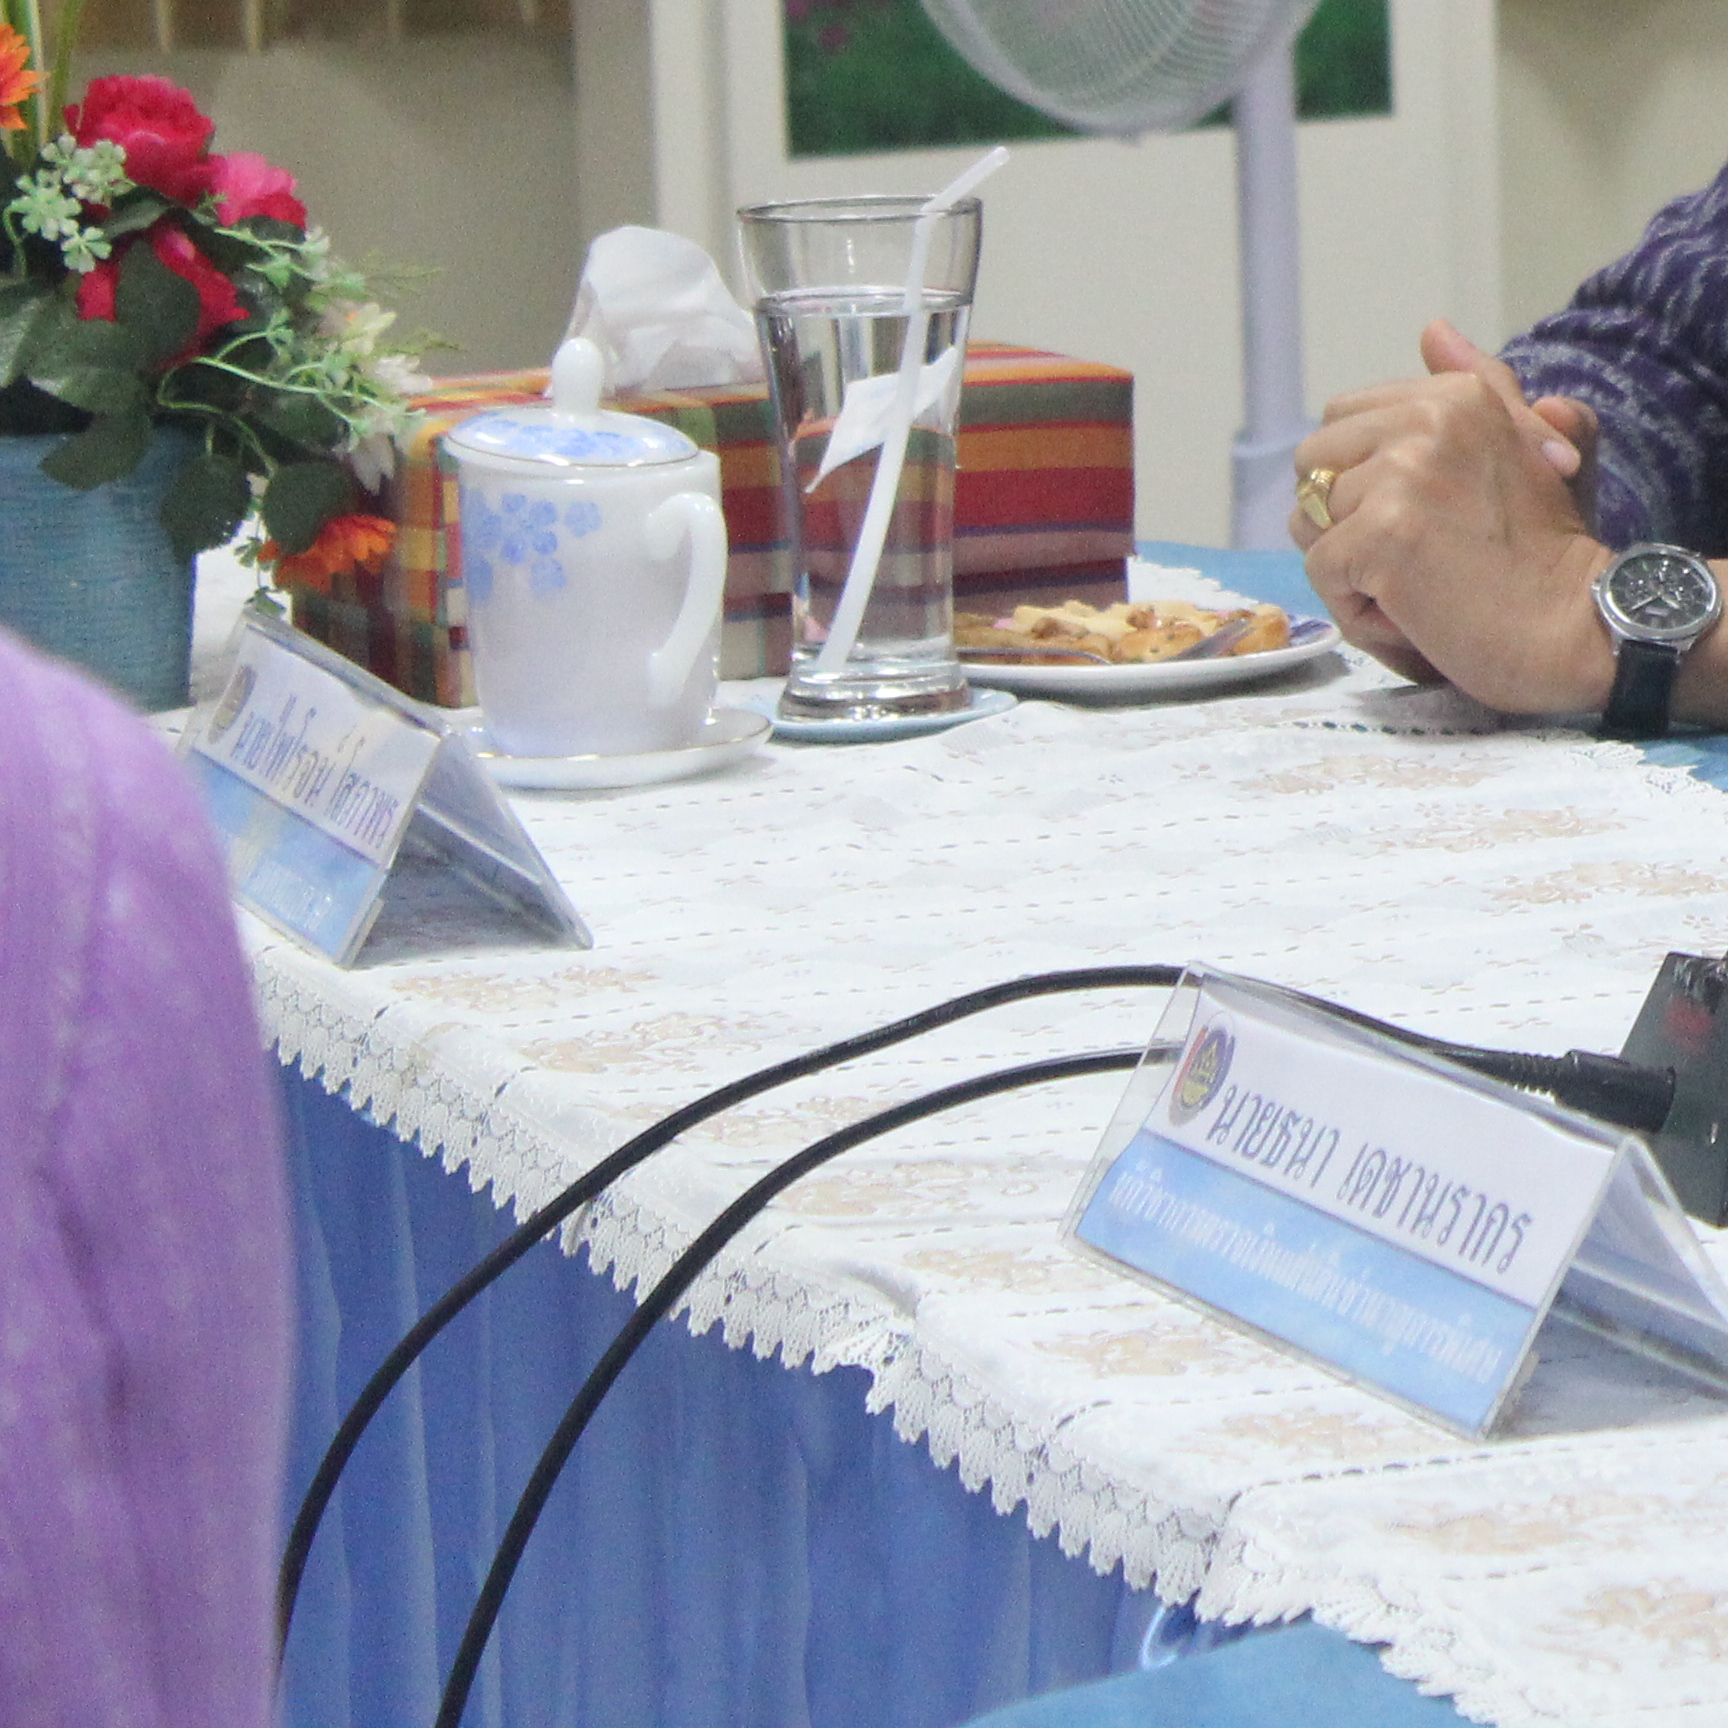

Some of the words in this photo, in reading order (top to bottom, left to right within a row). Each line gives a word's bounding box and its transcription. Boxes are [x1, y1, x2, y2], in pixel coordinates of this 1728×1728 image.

[1206, 1084, 1340, 1189] นายธนา
[1336, 1142, 1534, 1274] เดชานรากร
